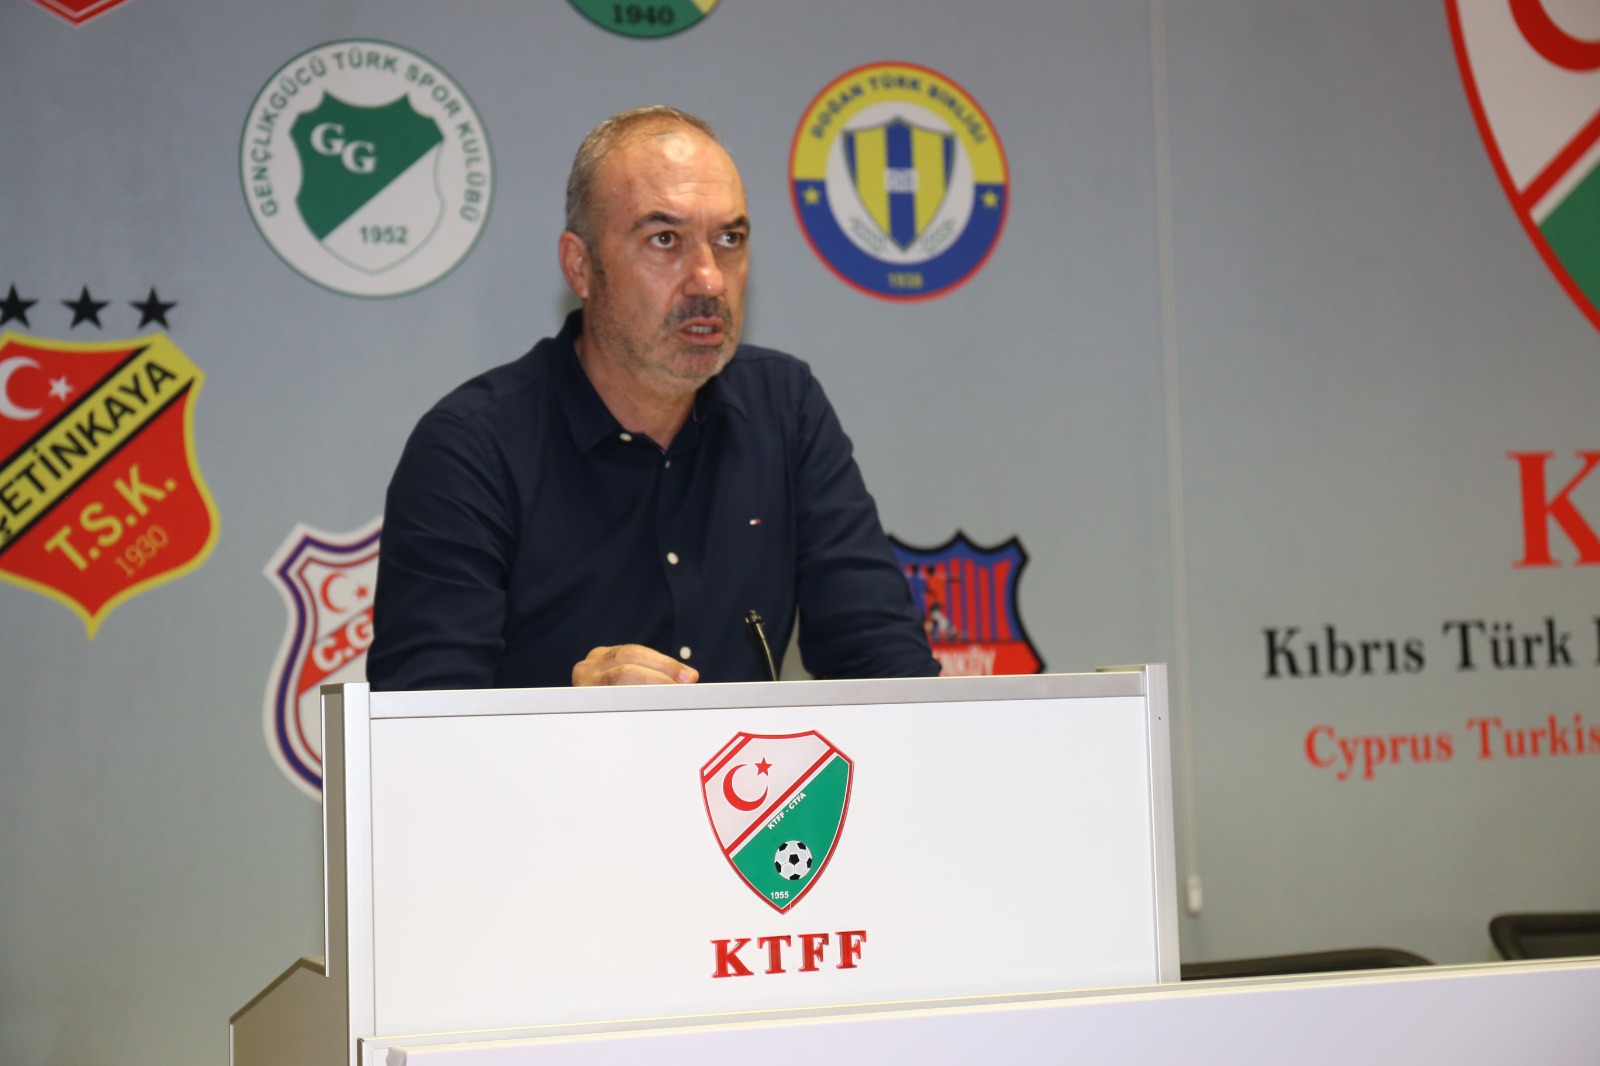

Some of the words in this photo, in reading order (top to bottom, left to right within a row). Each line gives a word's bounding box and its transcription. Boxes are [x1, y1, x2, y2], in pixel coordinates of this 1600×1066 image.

[613, 4, 675, 25] 1940
[332, 47, 398, 75] TÜRK
[404, 63, 461, 119] SPOR
[455, 119, 485, 223] KULÜBÜ
[360, 225, 408, 245] 1952
[44, 464, 177, 571] T.S.K.
[114, 524, 169, 577] 1930
[1262, 623, 1426, 679] Kıbrıs
[1442, 615, 1576, 671] Türk
[1304, 723, 1454, 782] Cyprus
[767, 811, 785, 830] KTFF
[788, 792, 806, 810] CTFA
[770, 890, 789, 900] 1955
[709, 929, 867, 979] KTFF
